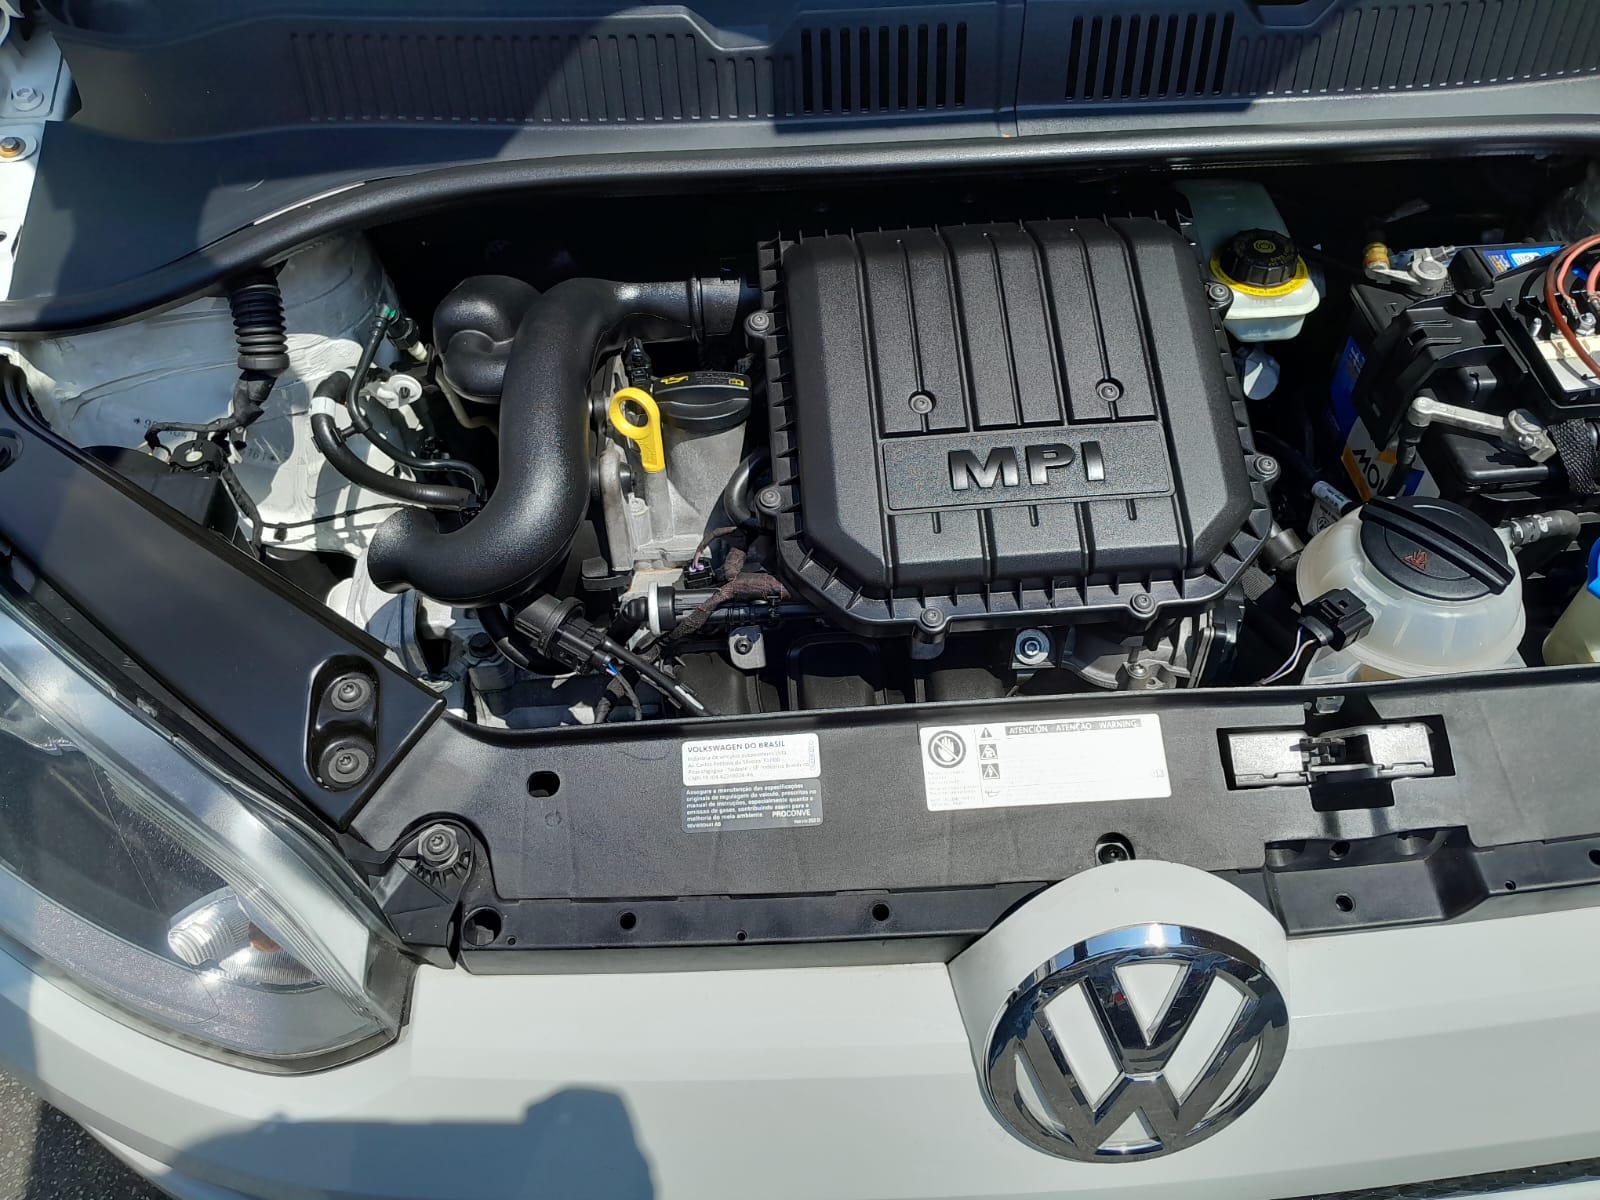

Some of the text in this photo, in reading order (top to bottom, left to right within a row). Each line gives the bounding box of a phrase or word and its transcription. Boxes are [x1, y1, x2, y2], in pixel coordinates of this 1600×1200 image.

[948, 441, 1106, 491] MPI
[1009, 724, 1048, 734] ATENCIÓN
[1099, 719, 1137, 730] WARNING
[688, 740, 785, 753] VOLKSWAGEN DO BRASIL
[772, 809, 811, 818] PROCONVE
